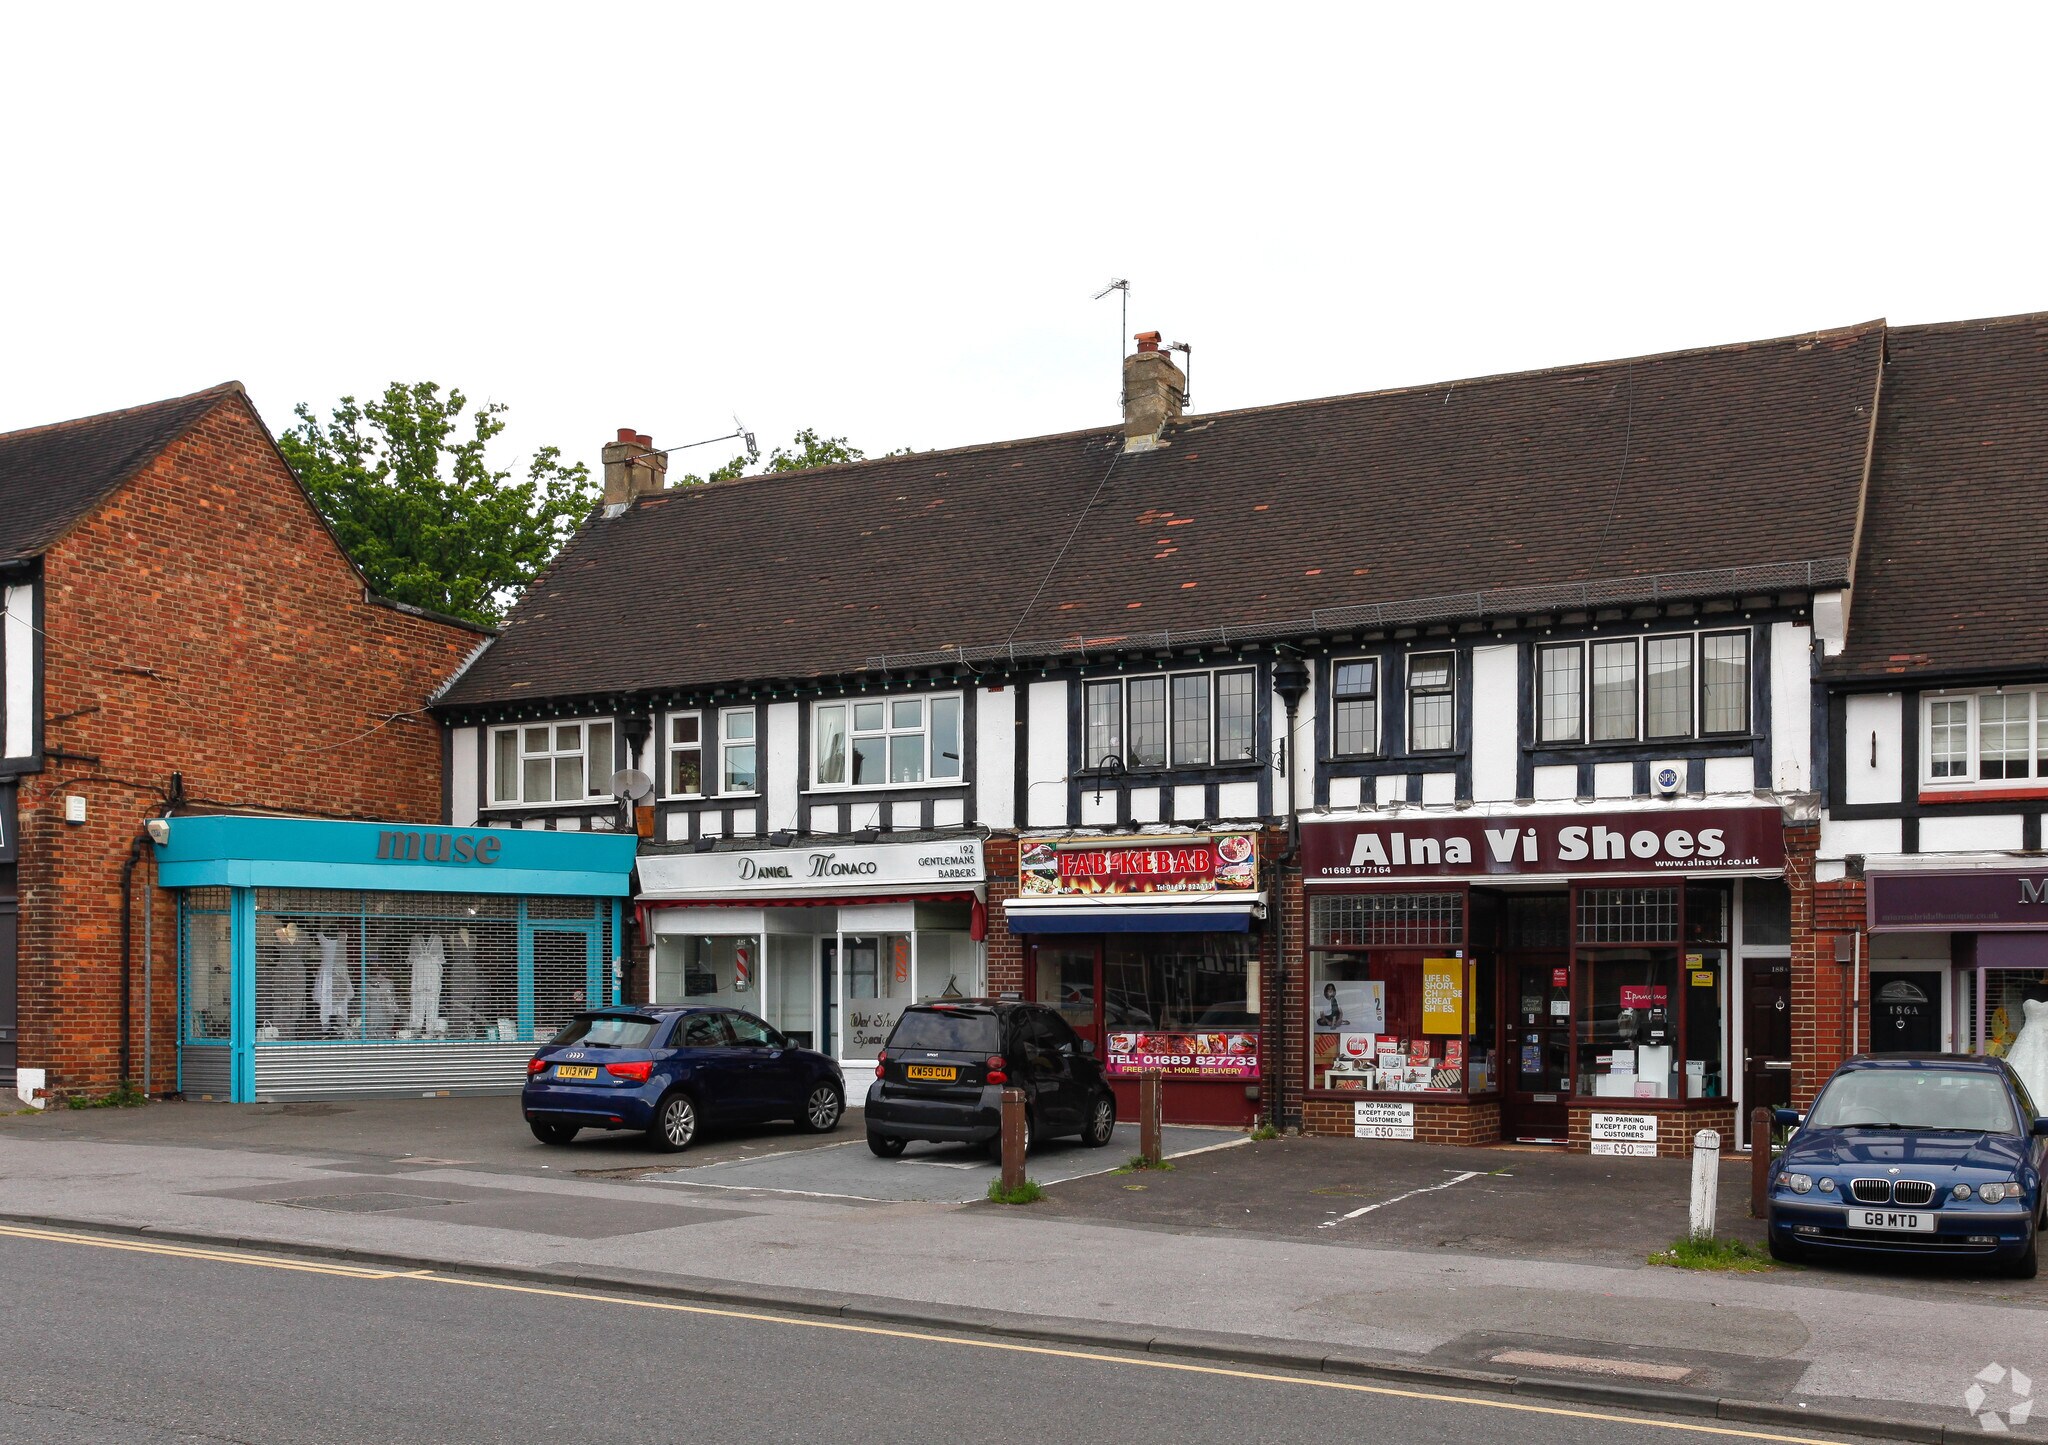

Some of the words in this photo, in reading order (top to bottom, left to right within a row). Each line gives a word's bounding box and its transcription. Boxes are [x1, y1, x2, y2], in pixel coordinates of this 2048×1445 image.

[376, 831, 502, 865] muse
[959, 844, 974, 854] 192
[1350, 832, 1472, 867] Alna
[1484, 827, 1539, 863] Vi
[1558, 825, 1726, 861] Shoes
[918, 855, 975, 867] GENTLEMANS
[1061, 848, 1210, 876] FAB-KEBAB
[1655, 856, 1760, 868] www.alnavi.co.uk
[938, 867, 976, 878] BARBERS
[1321, 867, 1351, 875] 01689
[1354, 866, 1391, 874] 877164
[1424, 974, 1441, 982] LIFE
[1442, 974, 1451, 982] IS
[1424, 982, 1455, 990] SHORT.
[1424, 989, 1462, 998] CHSE
[1424, 997, 1452, 1005] GREAT
[1889, 1005, 1919, 1015] 186A
[874, 1013, 896, 1028] Sha
[1108, 1054, 1139, 1065] TEL:
[1143, 1055, 1191, 1065] 01689
[1195, 1056, 1257, 1066] 827733
[559, 1066, 577, 1076] LV13
[578, 1066, 594, 1077] KWF
[911, 1066, 934, 1077] KW59
[935, 1067, 952, 1078] CUA
[1202, 1067, 1243, 1075] DELIVERY
[1375, 1127, 1393, 1137] £50
[1614, 1144, 1634, 1154] £50
[1864, 1212, 1884, 1226] G8
[1887, 1213, 1918, 1228] MTD
